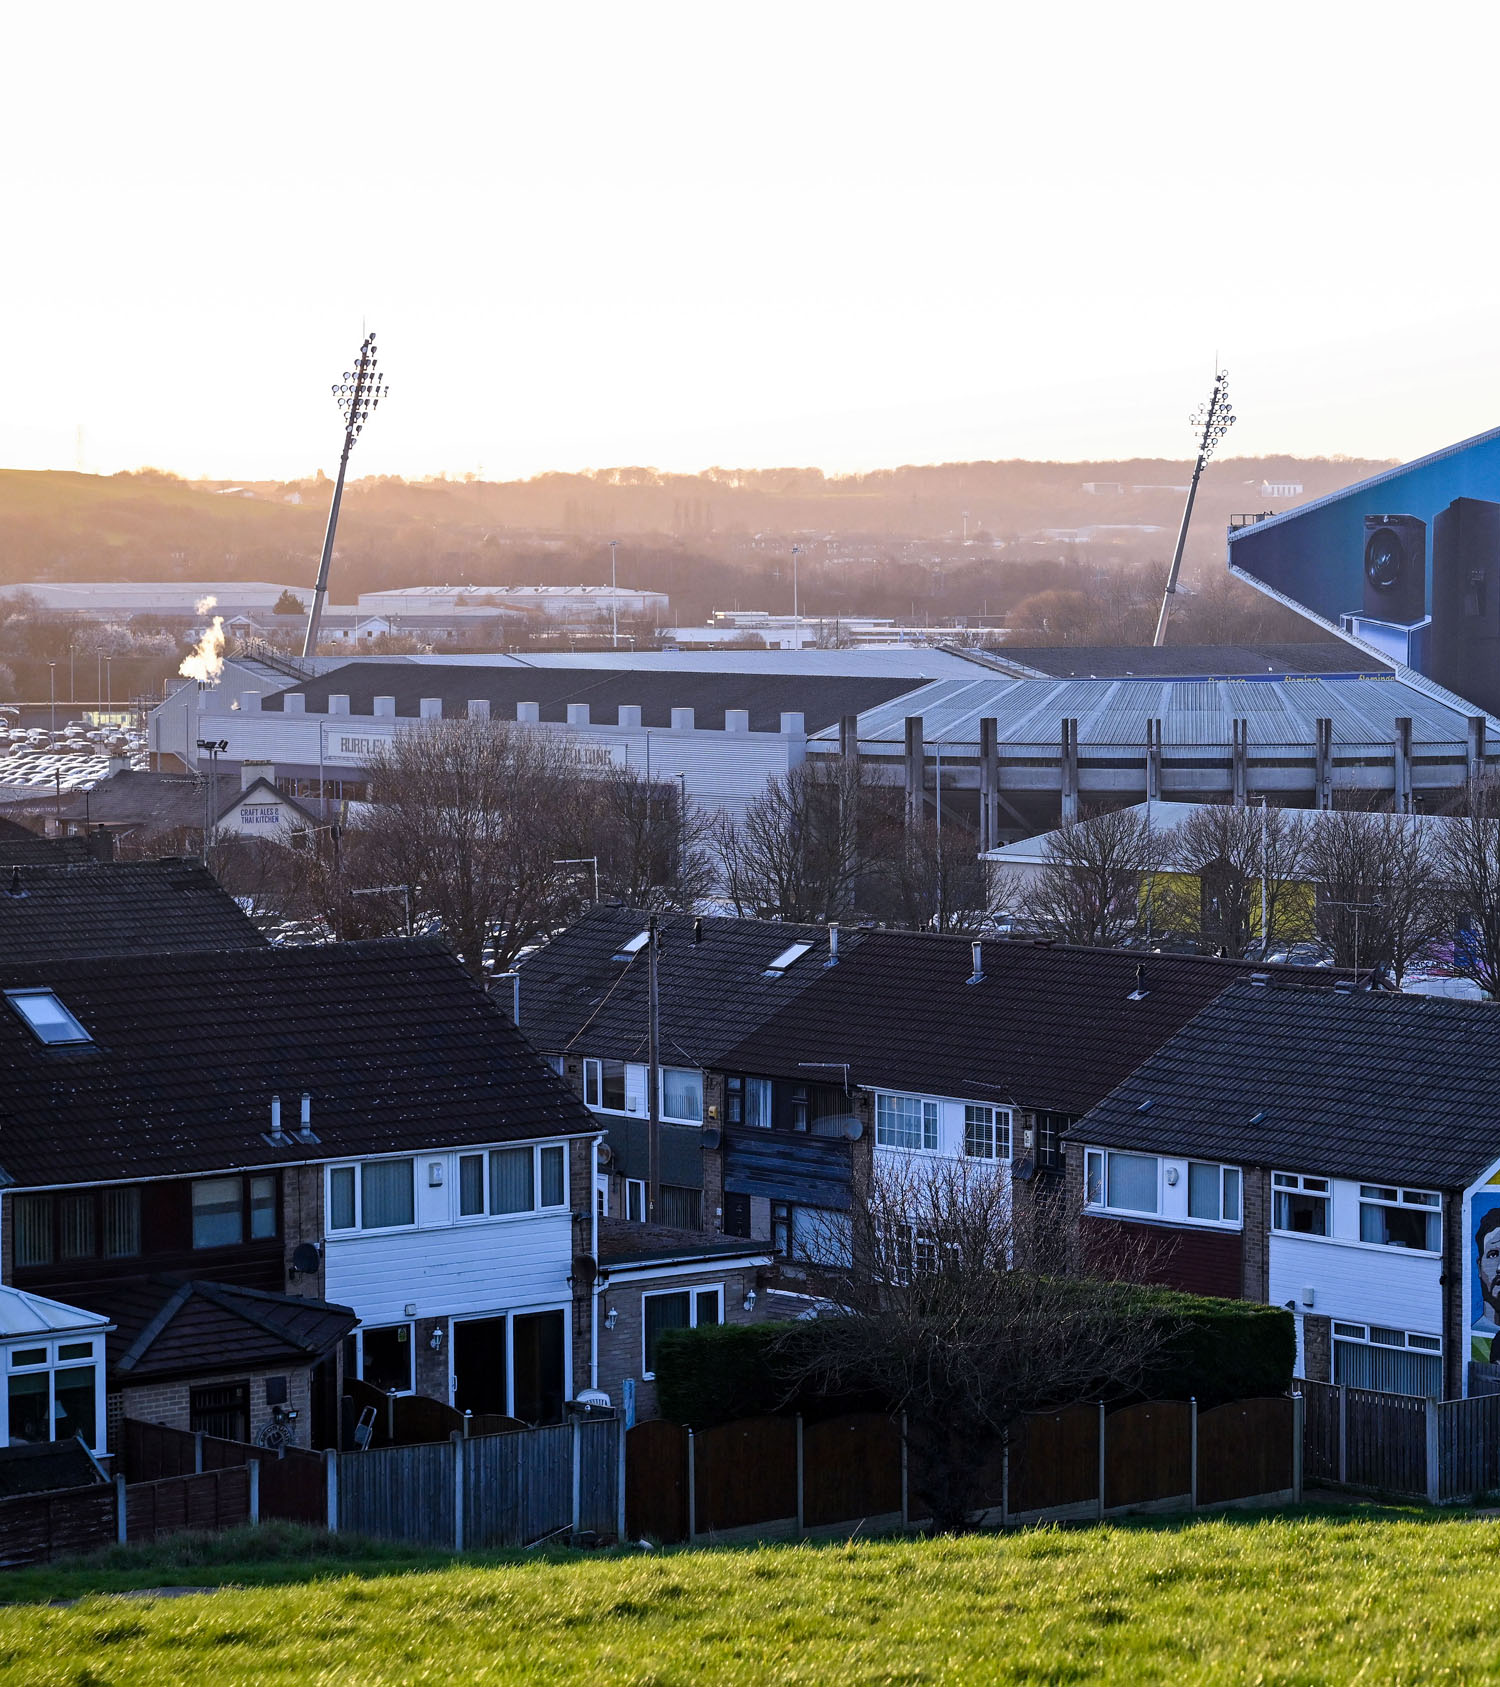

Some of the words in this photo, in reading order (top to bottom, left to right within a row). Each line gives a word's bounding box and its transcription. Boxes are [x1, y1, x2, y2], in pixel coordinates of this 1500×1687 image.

[240, 808, 259, 817] CRAFT
[259, 807, 274, 816] ALES
[241, 816, 255, 824] THAI
[255, 815, 280, 824] KITCHEN
